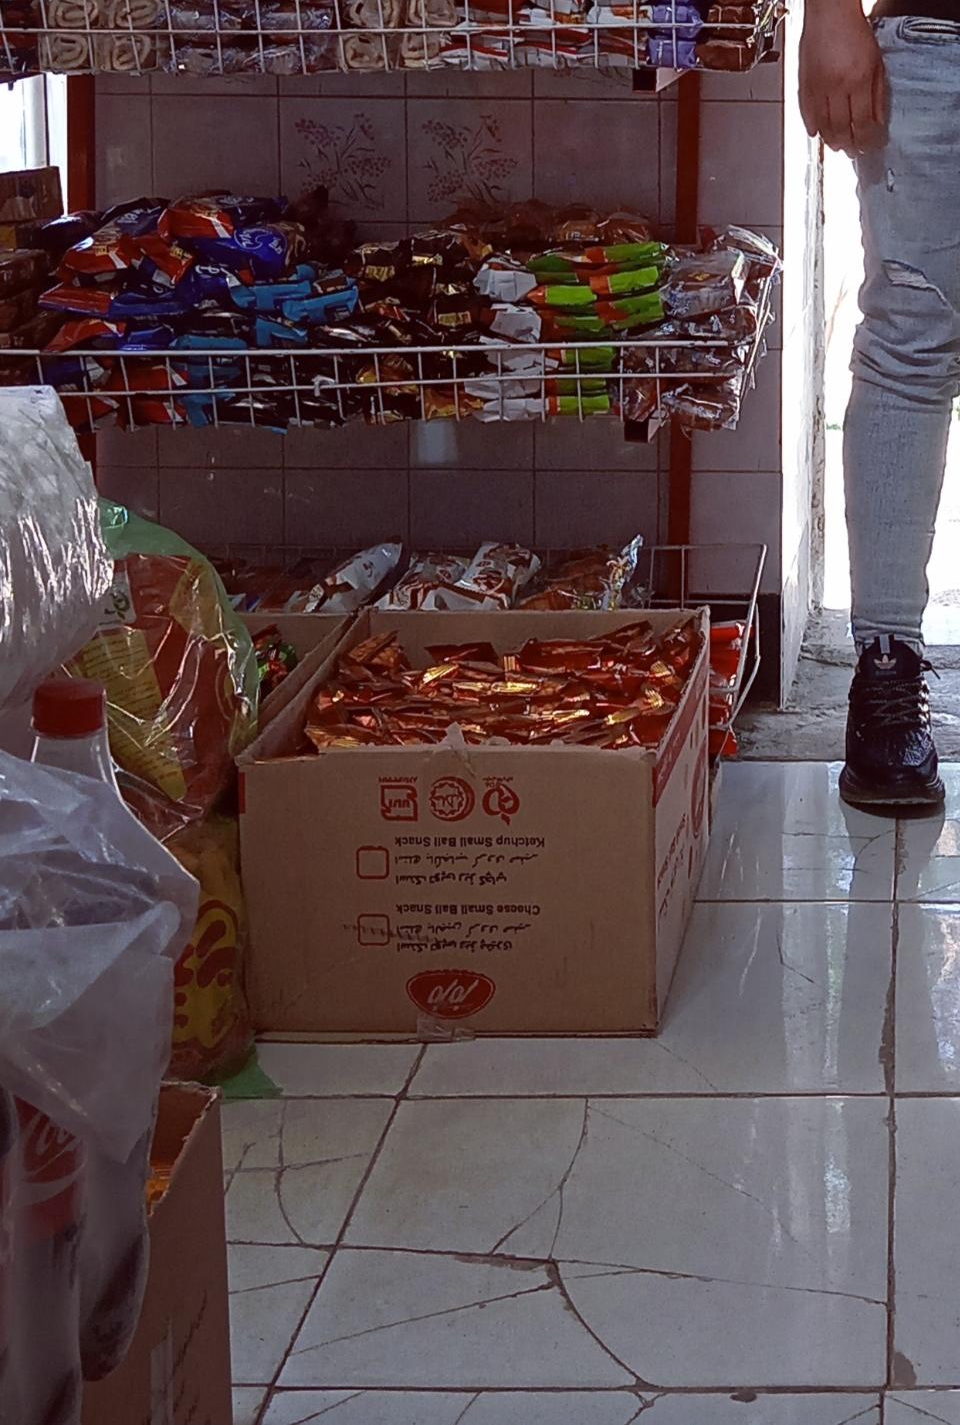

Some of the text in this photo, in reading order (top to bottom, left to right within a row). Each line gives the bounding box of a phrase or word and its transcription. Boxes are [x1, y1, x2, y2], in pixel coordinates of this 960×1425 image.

[394, 835, 545, 848] Ketchup Small Ball Snack
[395, 904, 432, 915] Snack
[435, 904, 458, 915] Ball
[461, 904, 494, 915] Small
